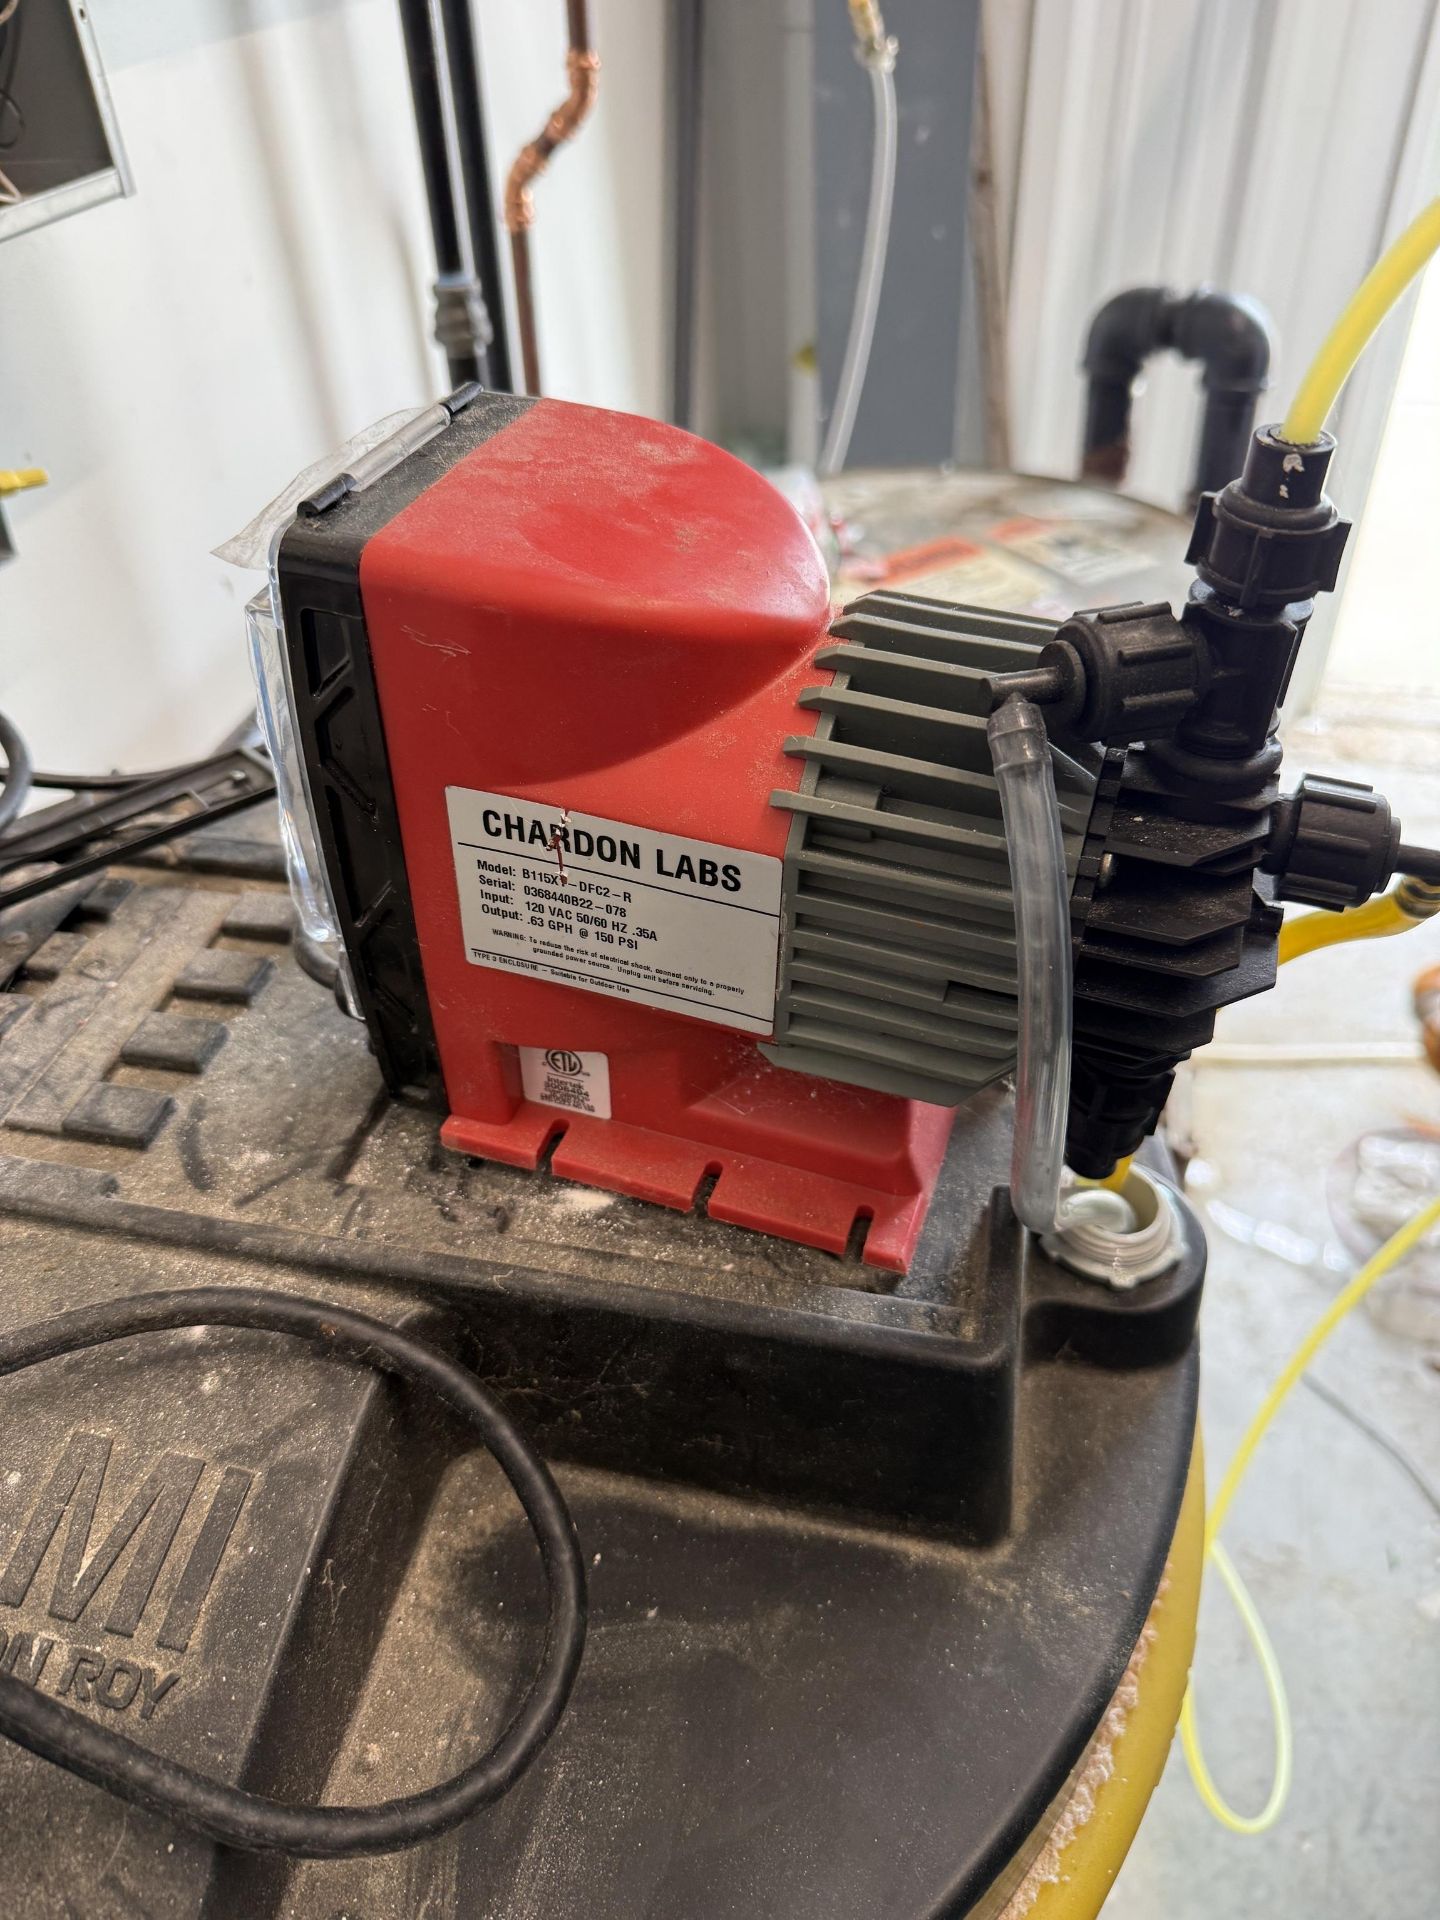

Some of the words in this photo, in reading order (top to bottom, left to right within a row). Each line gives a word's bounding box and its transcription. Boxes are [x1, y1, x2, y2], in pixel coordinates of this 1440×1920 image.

[483, 810, 640, 869] CHARDON
[656, 849, 741, 892] LABS
[477, 859, 516, 876] Model:
[522, 868, 631, 903] B115X-DFC2-R
[479, 875, 516, 891] Serial:
[524, 885, 627, 918] 0368440B22-078
[480, 889, 514, 905] Input:
[526, 901, 545, 914] 120
[548, 905, 573, 920] VAC
[576, 912, 607, 929] 50/60
[612, 920, 627, 934] HZ
[632, 927, 658, 941] .35A
[481, 904, 524, 921] Output:
[527, 915, 545, 927] .63
[548, 919, 573, 935] GPH
[579, 928, 589, 940] @
[595, 931, 614, 944] 150
[618, 936, 638, 950] PSI
[473, 951, 491, 961] TYPE
[498, 956, 539, 971] ENCLOSURE
[550, 968, 577, 981] Suitable
[578, 976, 588, 984] for
[589, 978, 615, 990] Outdoor
[616, 984, 630, 994] Use
[492, 928, 527, 941] WARNING:
[529, 936, 538, 944] To
[540, 939, 562, 950] reduce
[564, 944, 575, 953] the
[576, 948, 589, 957] risk
[590, 951, 598, 959] of
[599, 954, 629, 966] electrical
[630, 961, 653, 973] shock,
[655, 968, 682, 980] connect
[684, 974, 698, 984] only
[700, 977, 708, 985] to
[716, 982, 745, 995] properly
[532, 946, 563, 959] grounded
[565, 953, 587, 965] power
[588, 959, 613, 971] source.
[617, 966, 641, 979] Unplug
[643, 973, 656, 982] unit
[658, 977, 680, 988] before
[681, 982, 715, 996] servicing.
[57, 1644, 180, 1722] ROY
